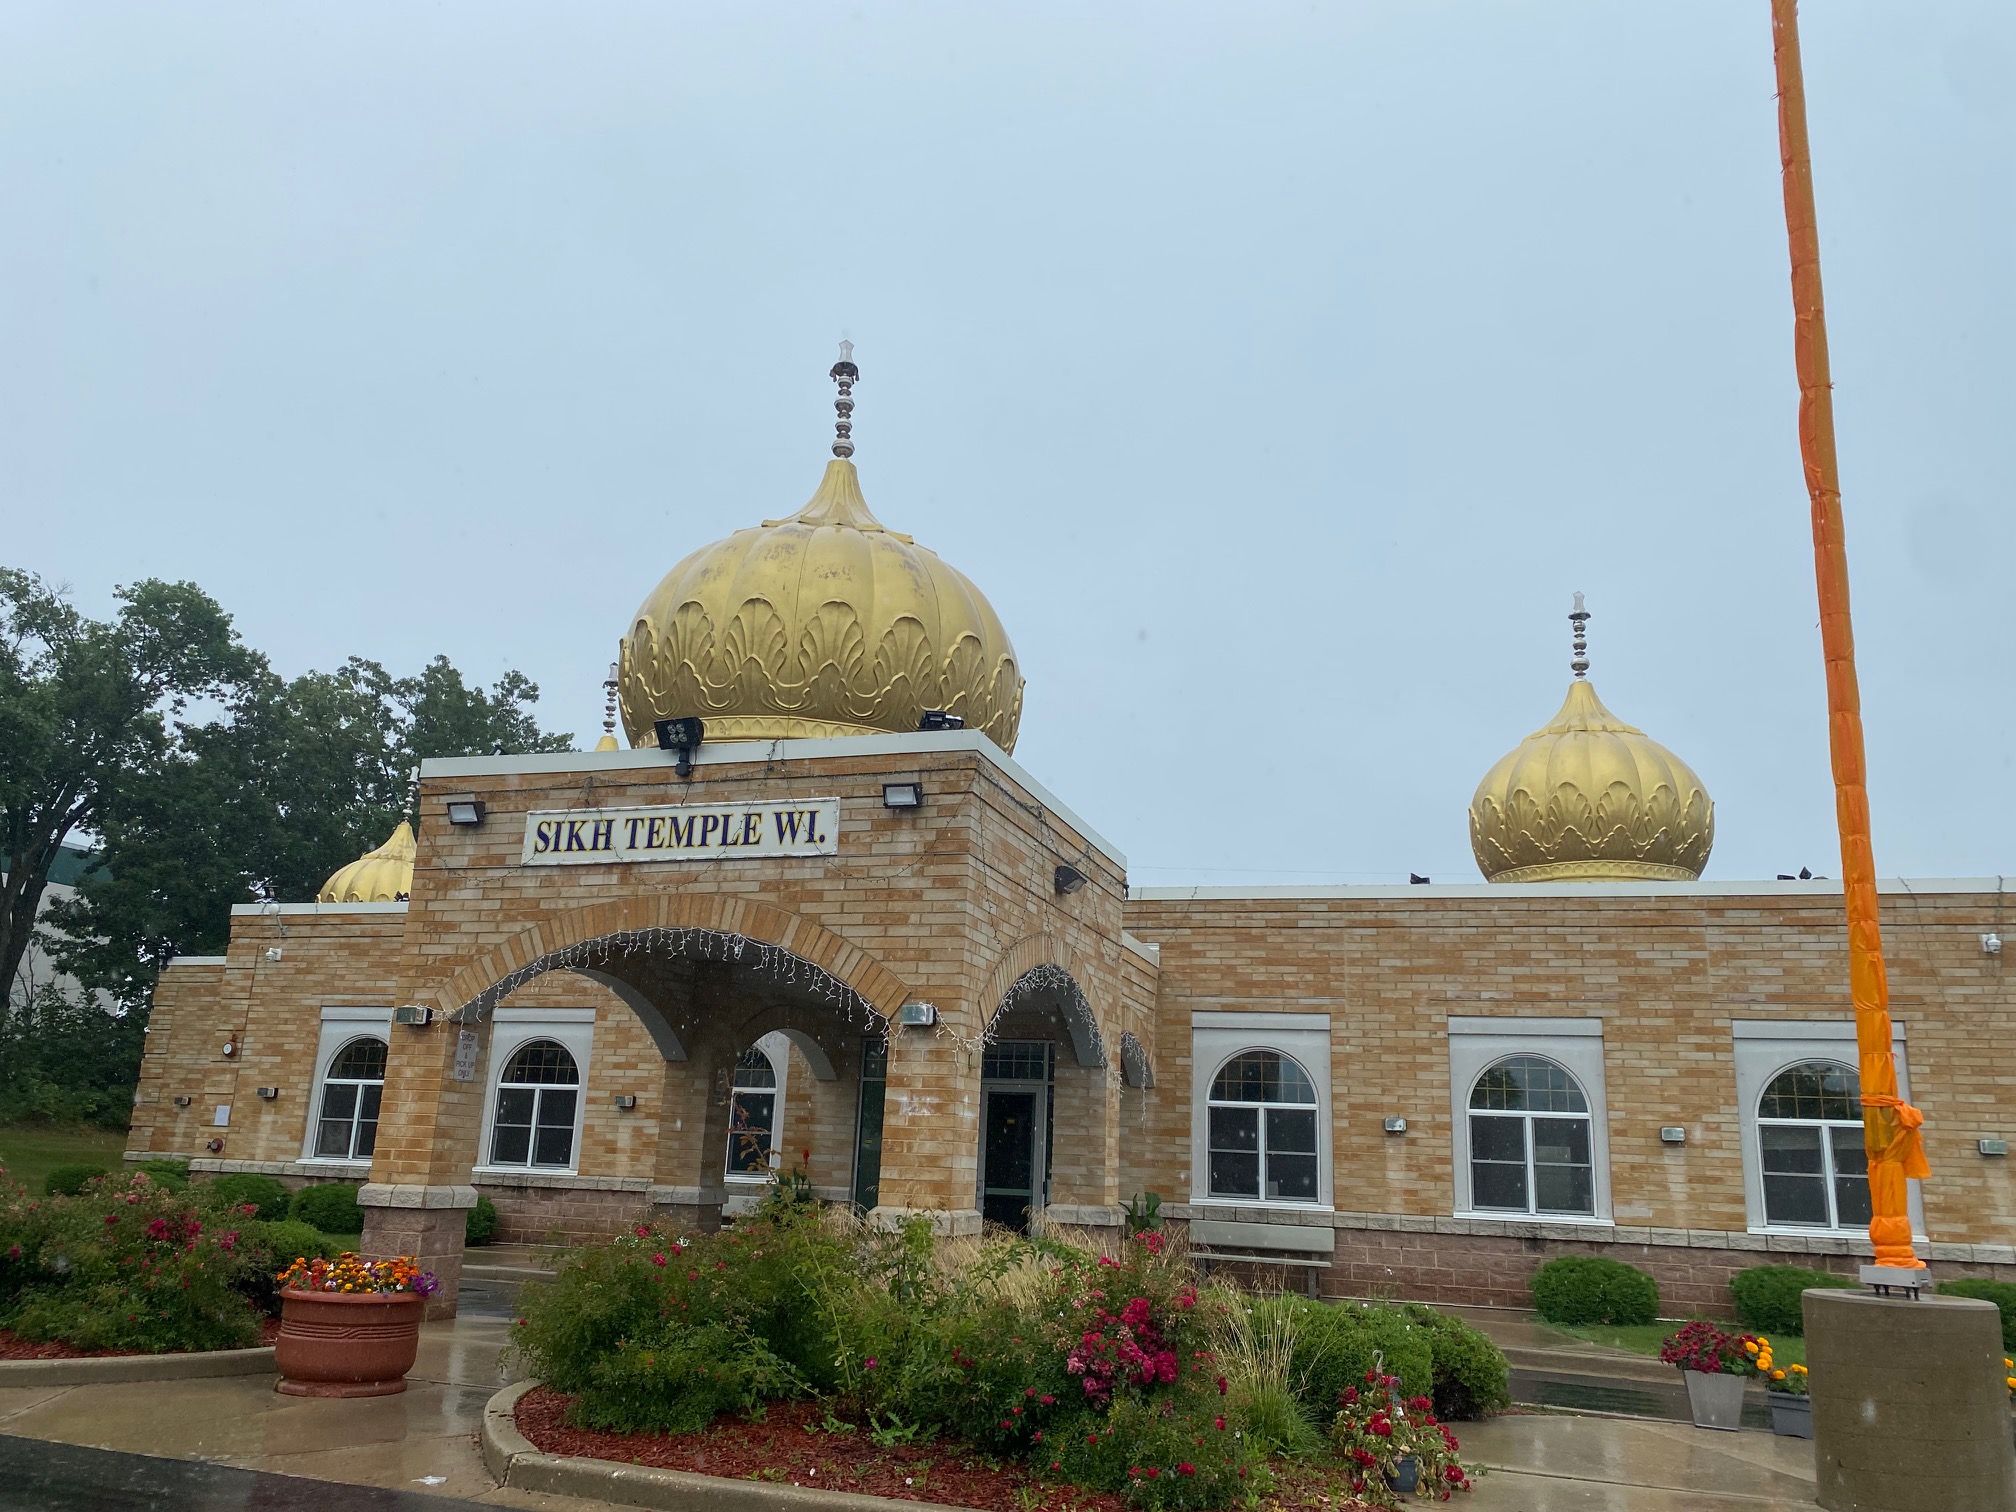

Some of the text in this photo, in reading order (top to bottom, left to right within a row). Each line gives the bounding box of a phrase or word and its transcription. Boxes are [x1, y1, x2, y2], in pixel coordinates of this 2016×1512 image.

[534, 809, 827, 854] SIKH TEMPLE WI.
